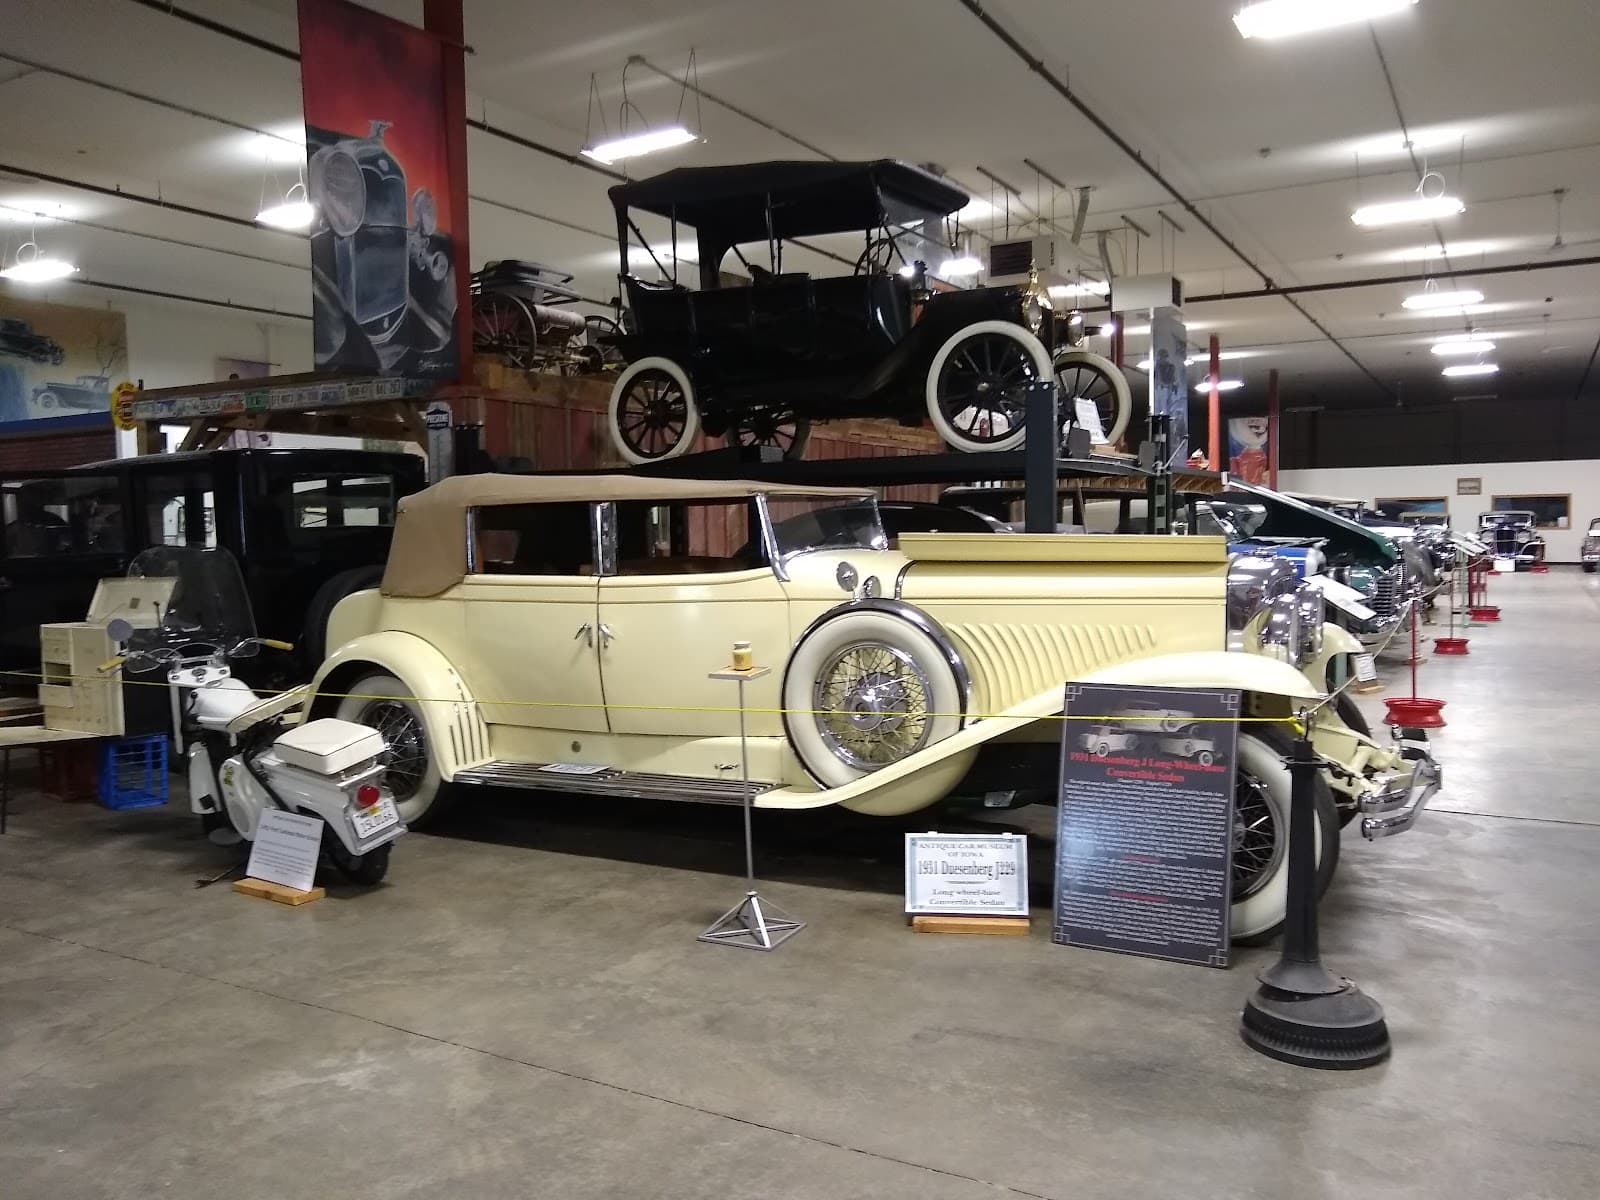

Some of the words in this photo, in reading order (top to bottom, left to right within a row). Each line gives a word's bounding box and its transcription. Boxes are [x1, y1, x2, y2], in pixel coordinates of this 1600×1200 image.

[918, 860, 938, 875] 1931
[941, 860, 993, 880] Duesenberg
[994, 861, 1016, 880] J229
[932, 888, 954, 897] Long
